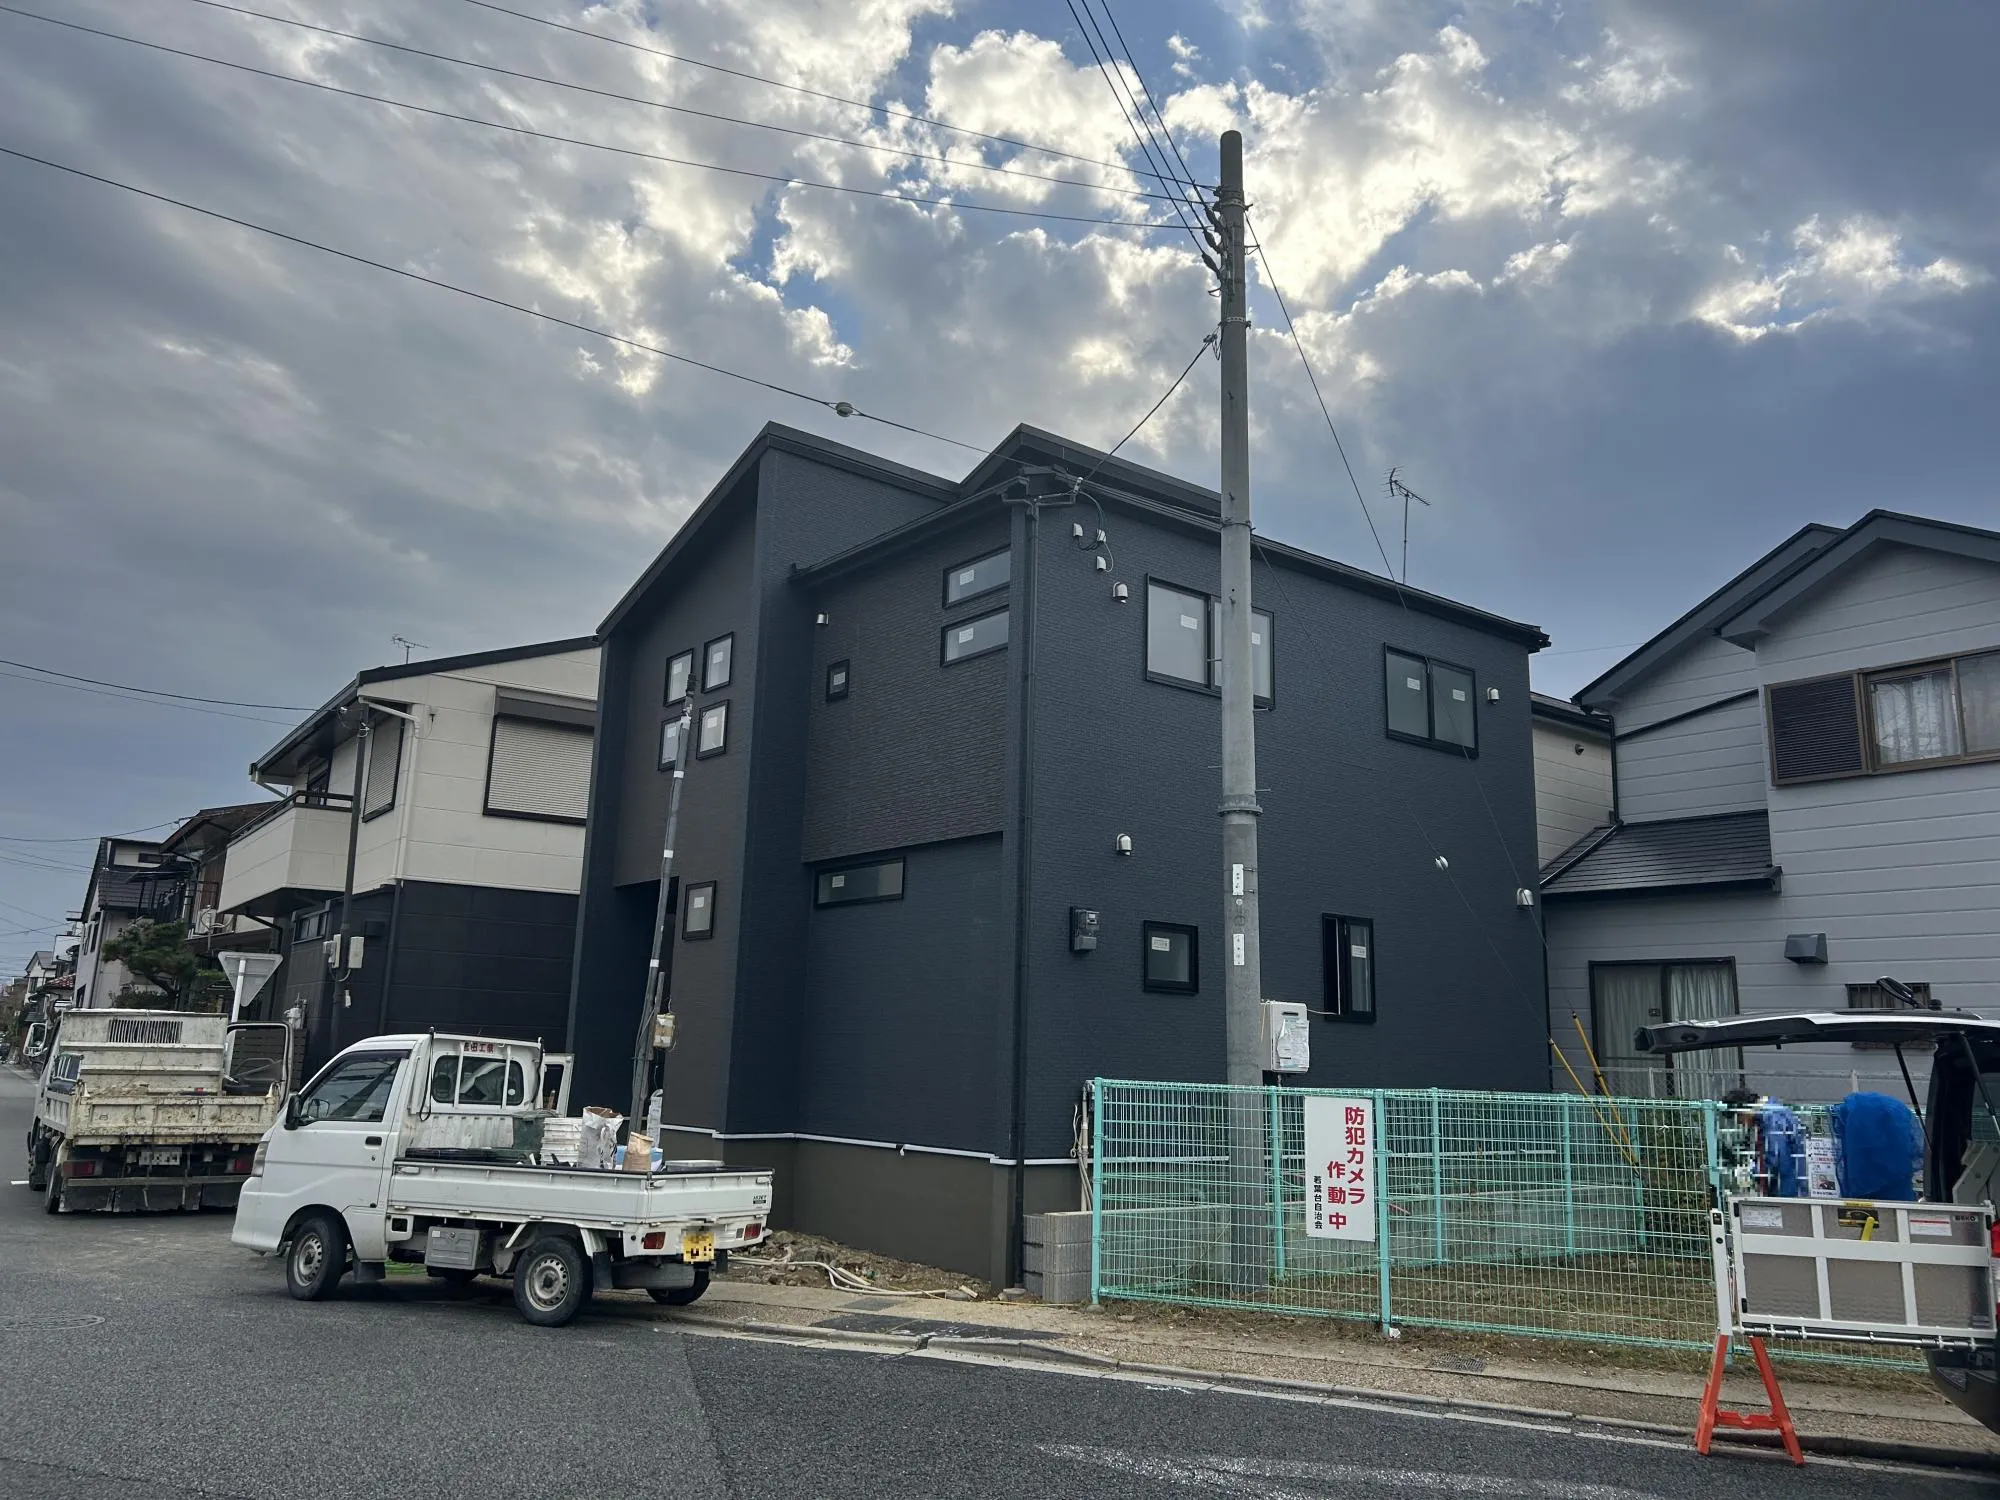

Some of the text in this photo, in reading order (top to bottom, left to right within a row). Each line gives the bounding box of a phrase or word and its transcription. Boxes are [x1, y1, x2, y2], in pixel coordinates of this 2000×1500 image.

[1327, 1160, 1347, 1230] 作動中
[1344, 1106, 1366, 1205] 防犯カメラ
